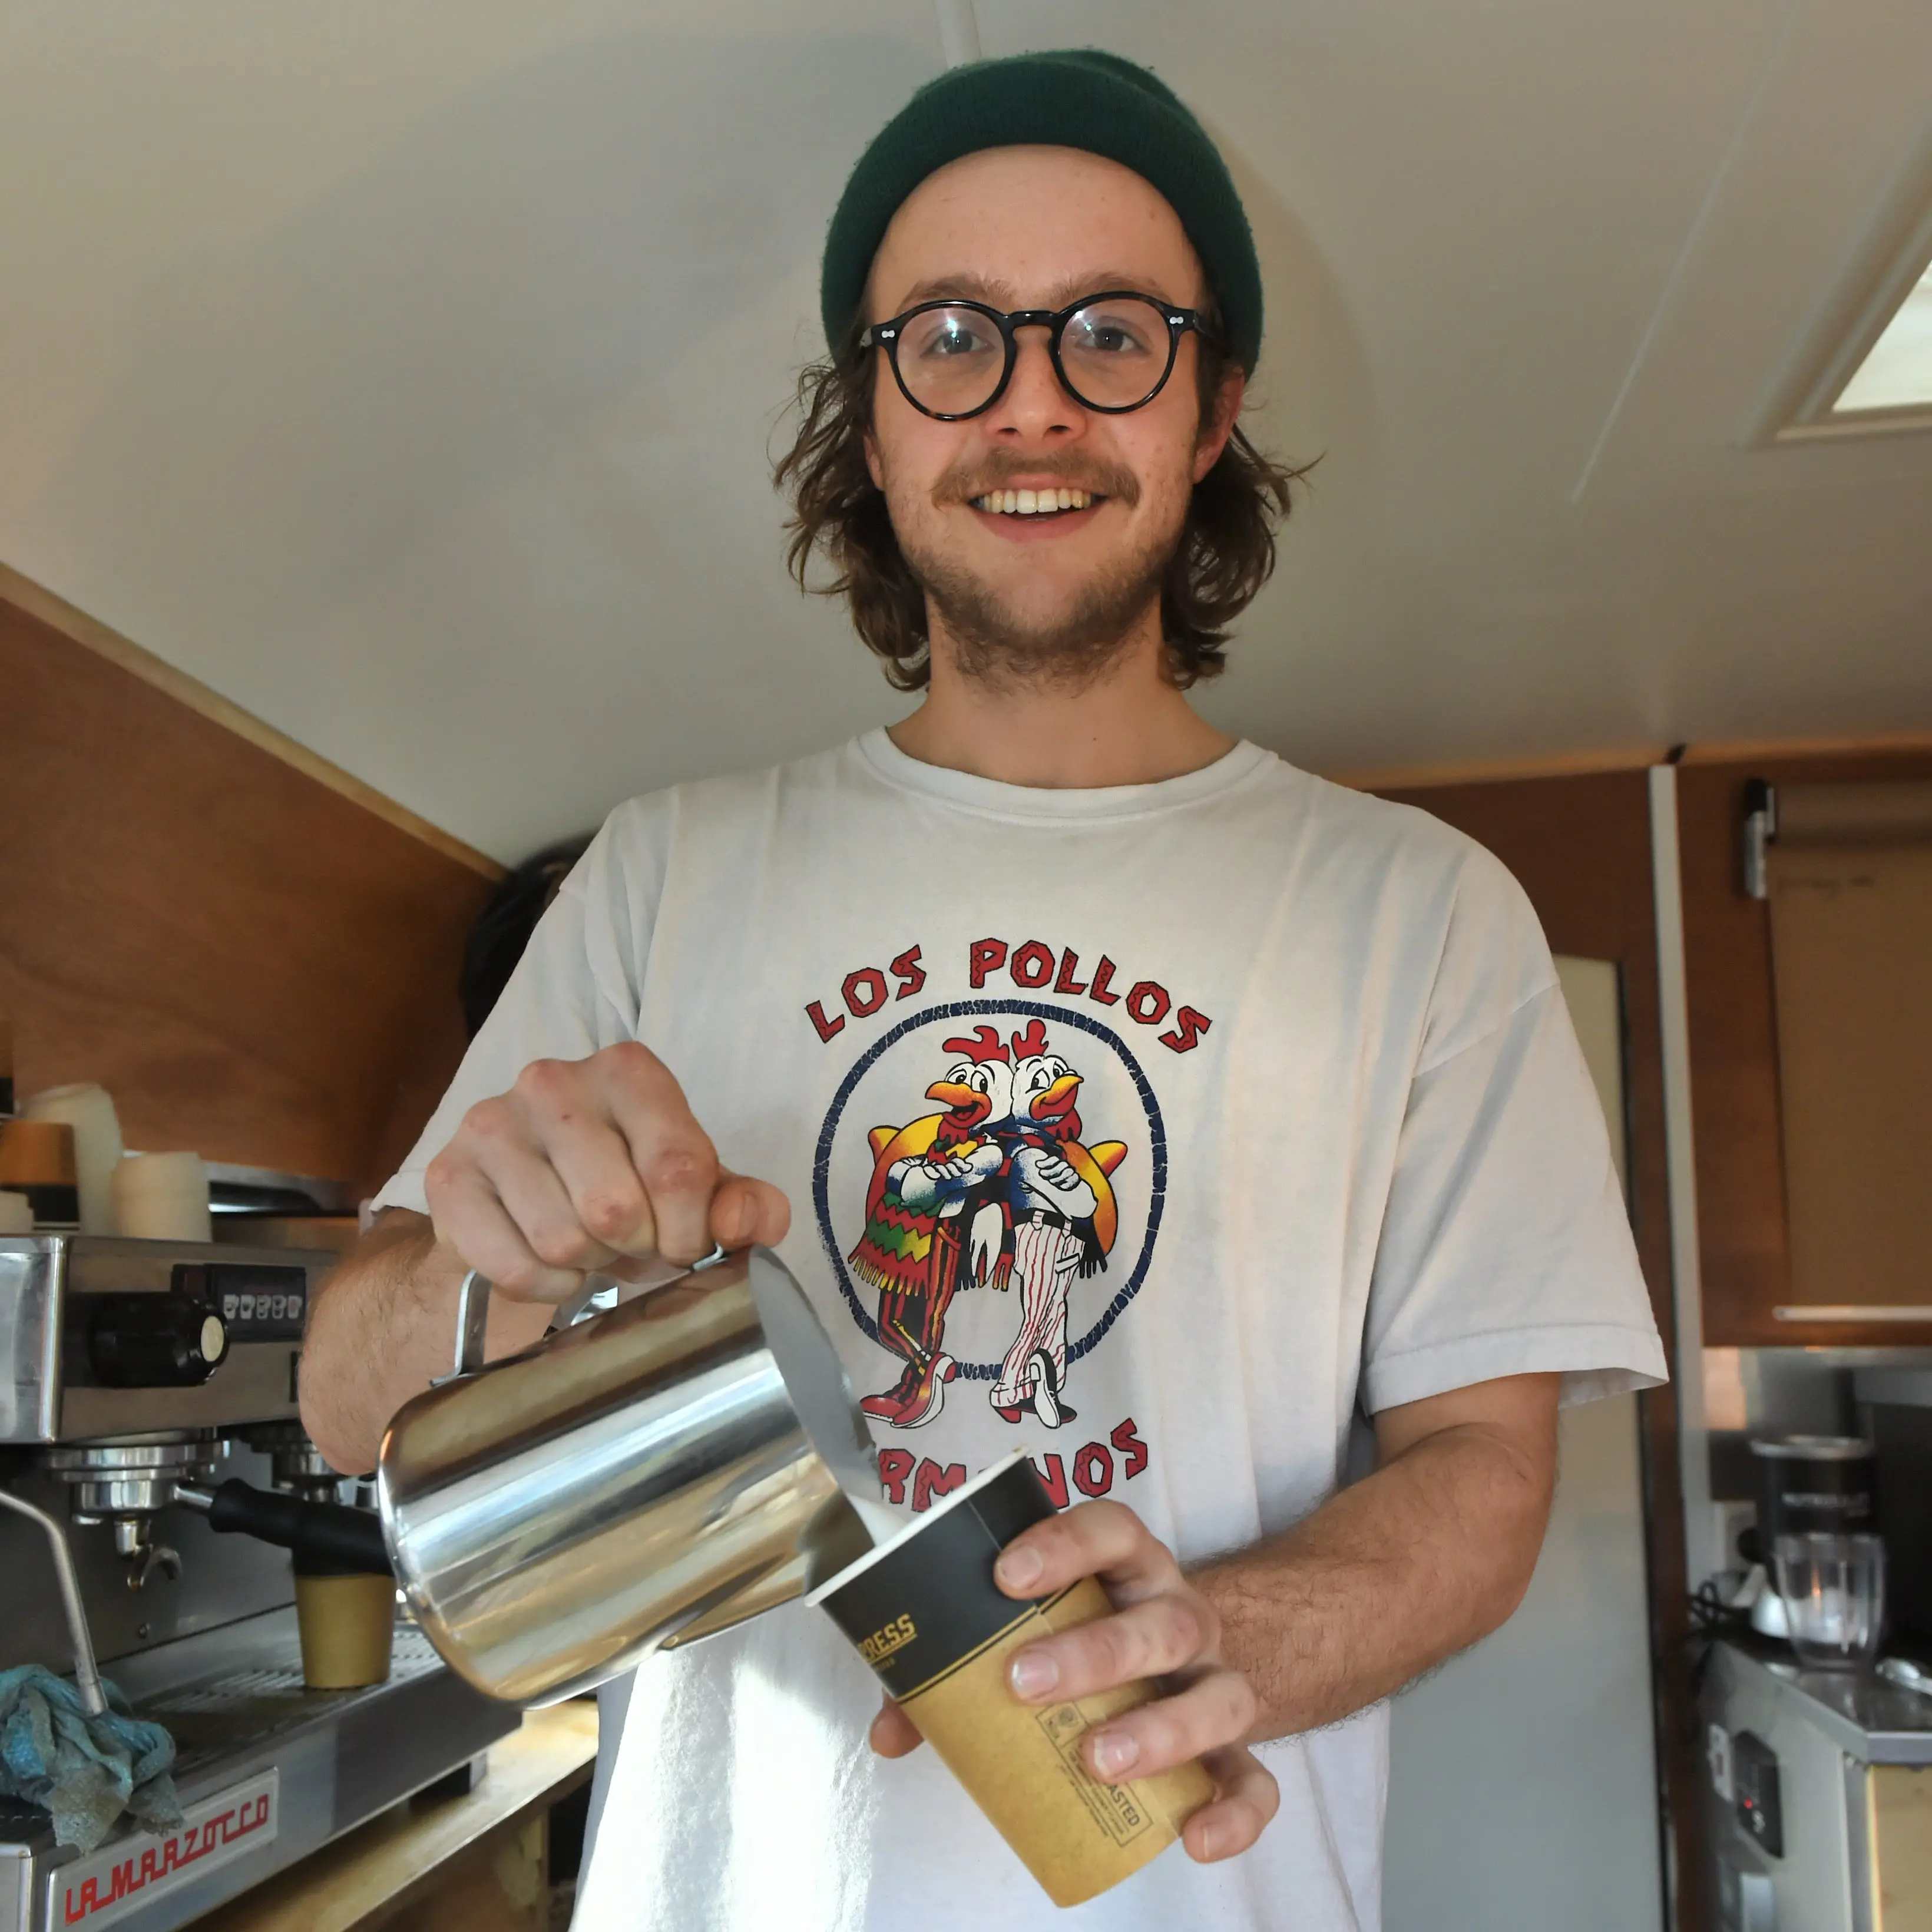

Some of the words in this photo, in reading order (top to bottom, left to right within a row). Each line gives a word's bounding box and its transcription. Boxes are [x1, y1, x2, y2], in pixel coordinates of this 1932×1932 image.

[805, 944, 927, 1043] LOS
[970, 938, 1212, 1053] POLLOS
[877, 1417, 1149, 1513] RMNOS
[1107, 1784, 1140, 1827] ASTED
[65, 1877, 100, 1927] LA
